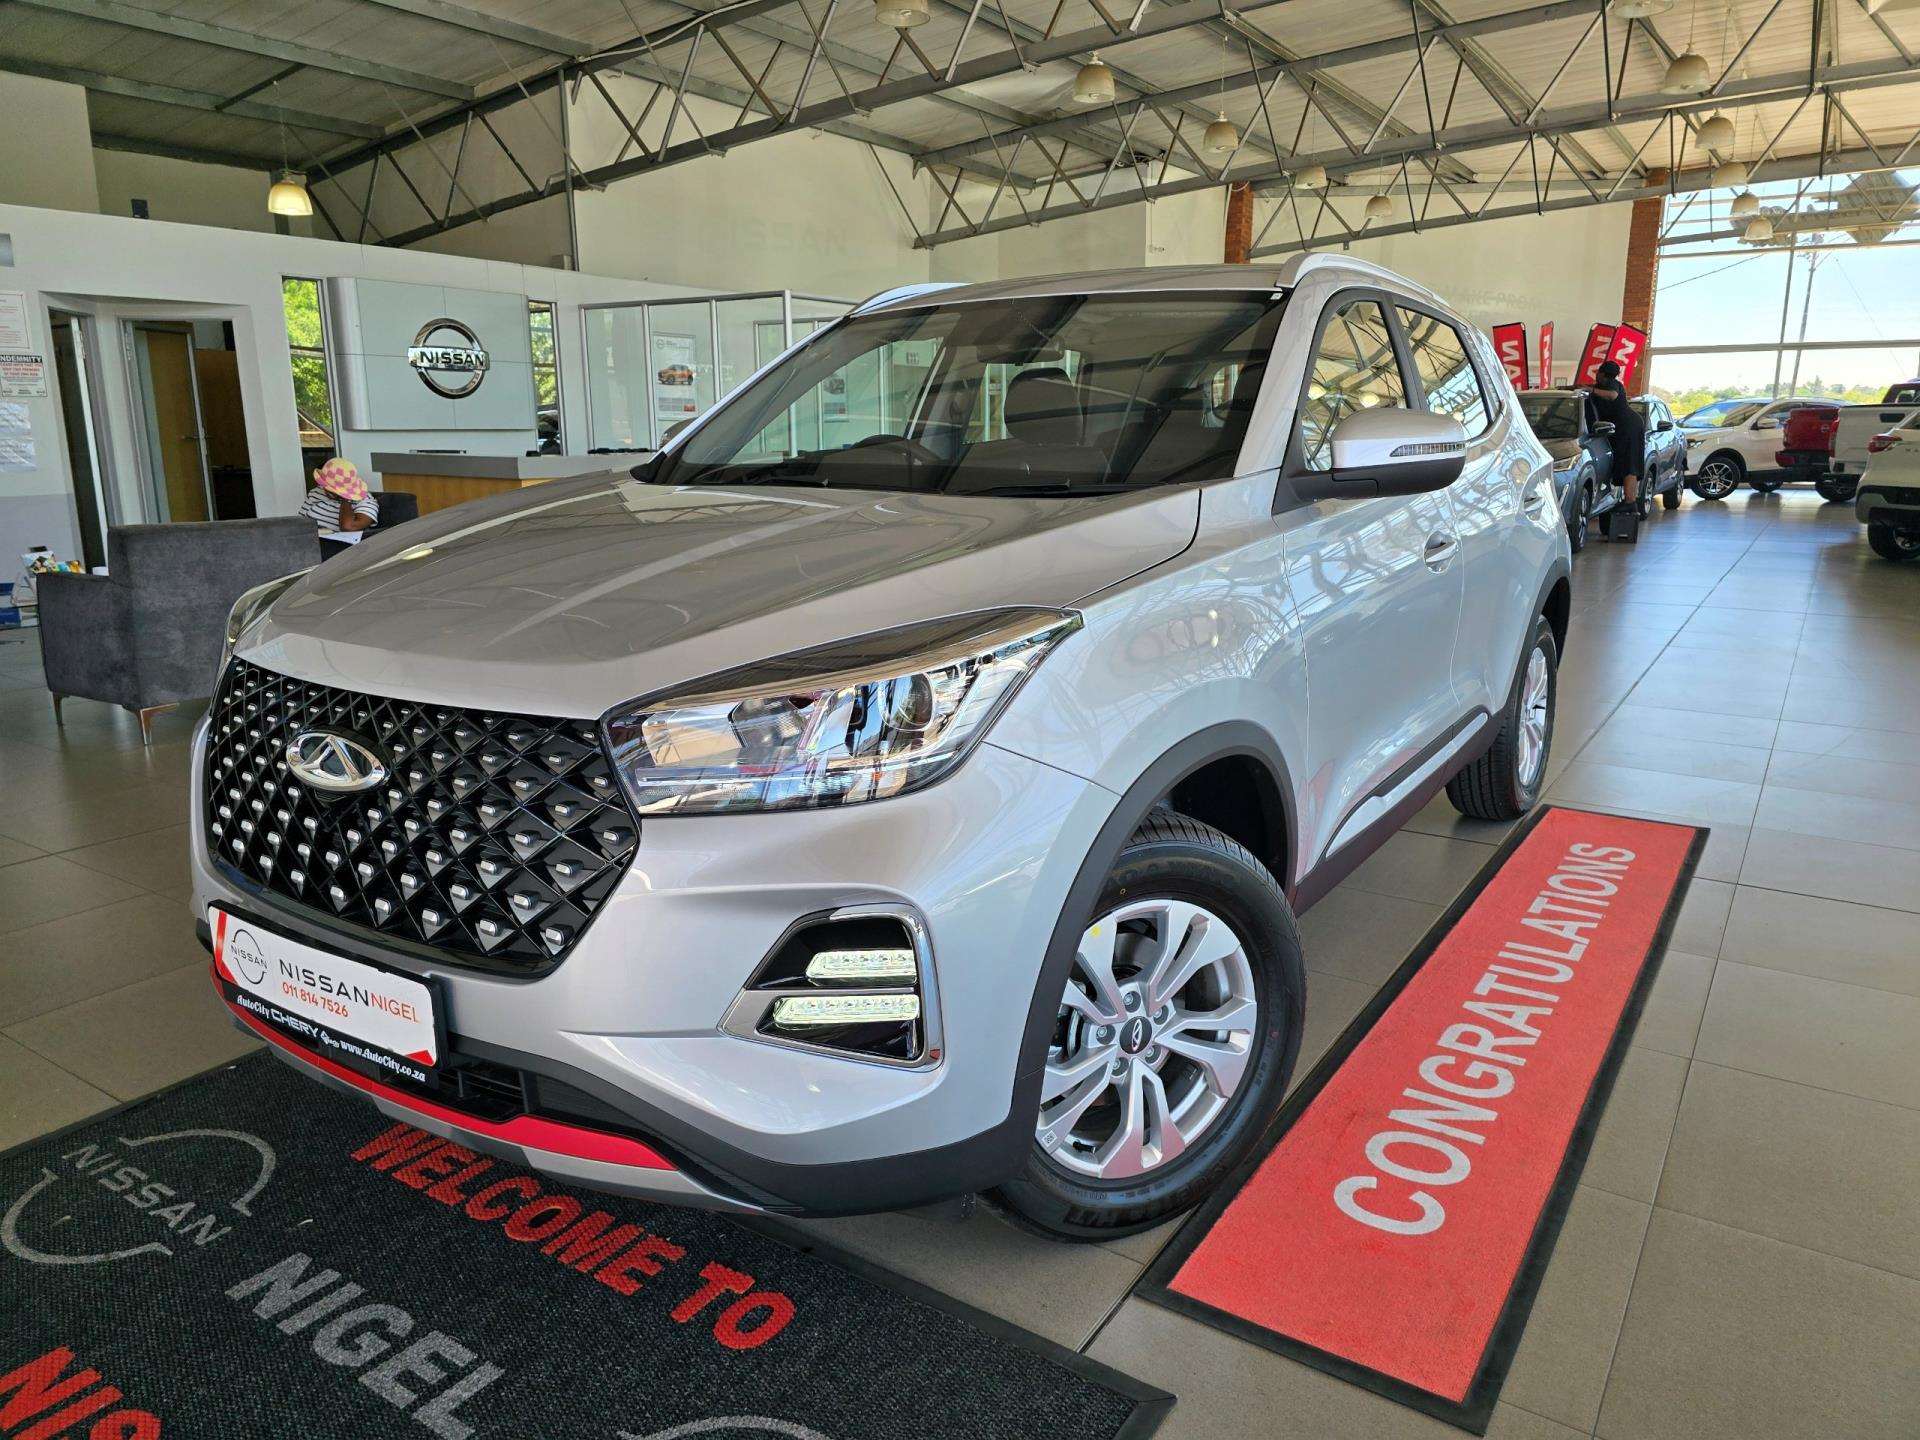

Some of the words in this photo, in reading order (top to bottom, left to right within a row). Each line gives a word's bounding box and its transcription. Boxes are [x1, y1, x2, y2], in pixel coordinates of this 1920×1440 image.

[0, 355, 42, 363] NDEMNITY
[420, 351, 484, 366] NISSAN
[231, 945, 268, 969] NISSAN
[282, 982, 298, 1000] 011
[300, 991, 318, 1007] 814
[320, 997, 349, 1018] 7526
[271, 1008, 318, 1038] CHERY
[1333, 843, 1636, 1235] CONGRATULATIONS
[62, 1144, 232, 1245] NISSAN
[350, 1121, 686, 1296] WELCOME
[670, 1260, 797, 1349] TO
[224, 1252, 506, 1440] NIGEL
